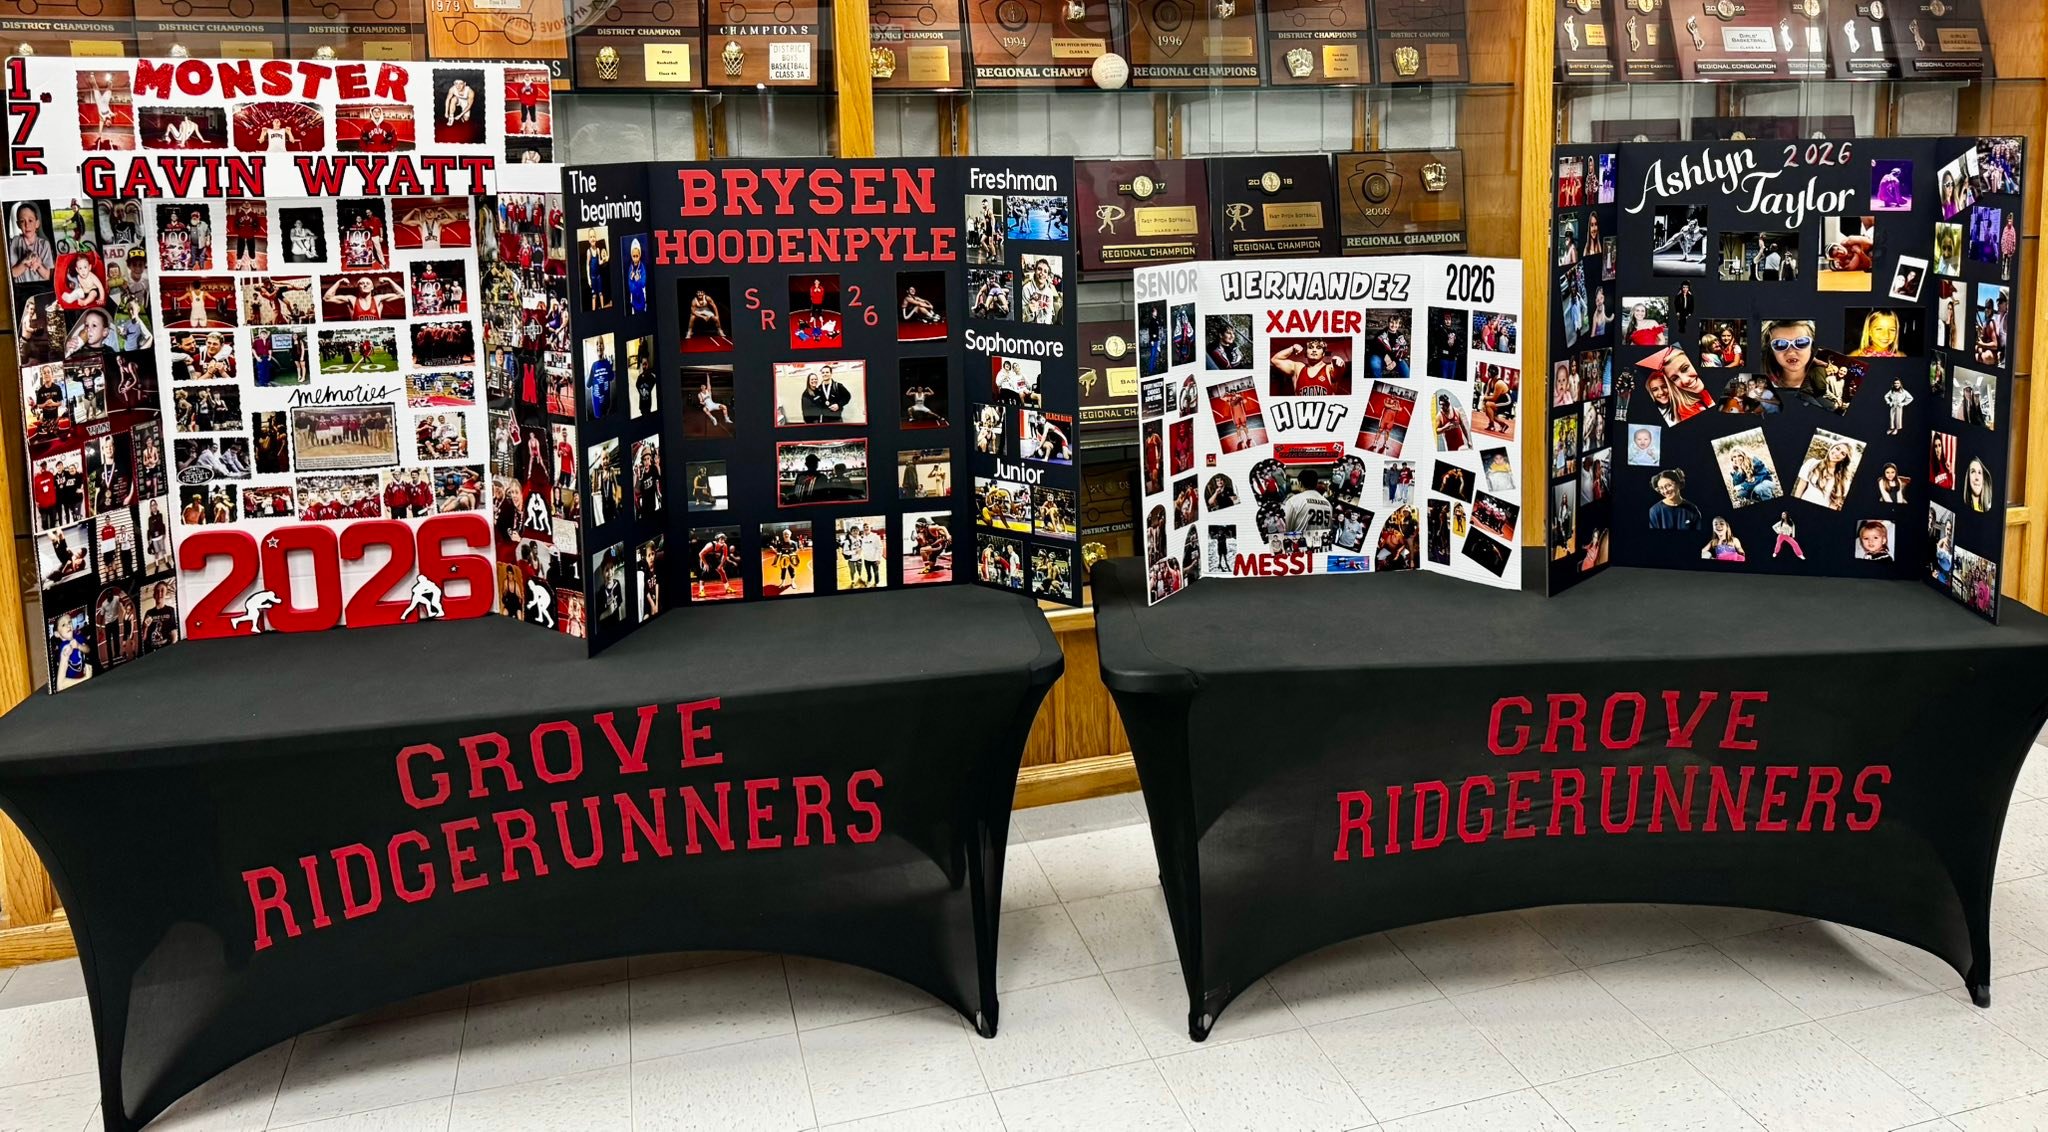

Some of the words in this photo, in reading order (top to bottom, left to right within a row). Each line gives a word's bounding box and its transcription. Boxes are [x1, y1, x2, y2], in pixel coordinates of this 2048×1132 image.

[431, 1, 460, 12] 1979
[2, 21, 50, 30] DISTRICT
[53, 22, 115, 32] CHAMPIONS
[158, 23, 204, 32] DISTRICT
[206, 24, 265, 33] CHAMPIONS
[309, 26, 350, 34] DISTRICT
[352, 26, 406, 34] CHAMPIONS
[597, 28, 635, 36] DISTRICT
[637, 28, 681, 36] CHAMPION
[720, 26, 809, 35] CHAMPIONS
[773, 45, 806, 53] DISTRICT
[1003, 37, 1027, 48] 1994
[1158, 36, 1182, 46] 1996
[771, 62, 808, 71] BASKETBALL
[782, 54, 798, 62] BOYS
[133, 59, 409, 101] MONSTER
[977, 67, 1040, 77] REGIONAL
[1134, 67, 1190, 77] REGIONAL
[1192, 66, 1257, 76] CHAMPIONS
[1783, 142, 1853, 168] 2026
[81, 156, 266, 199] GAVIN
[297, 155, 495, 198] WYATT
[569, 170, 597, 195] The
[970, 168, 1057, 192] Freshman
[1624, 148, 1757, 214] Ashlyn
[677, 168, 936, 218] BRYSEN
[1736, 170, 1855, 229] Taylor
[581, 195, 642, 225] beginning
[1365, 208, 1391, 216] 2006
[161, 231, 188, 243] 100
[655, 227, 956, 265] HOODENPYLE
[1233, 243, 1275, 252] REGIONAL
[1277, 241, 1320, 249] CHAMPION
[1347, 236, 1401, 247] REGIONAL
[1404, 233, 1460, 244] CHAMPION
[1102, 250, 1147, 258] REGIONAL
[1150, 247, 1195, 257] CHAMPION
[1136, 268, 1198, 300] SENIOR
[1221, 270, 1411, 301] HERNANDEZ
[1446, 263, 1496, 303] 2026
[1265, 309, 1362, 335] XAVIER
[965, 329, 1064, 358] Sophomore
[288, 384, 401, 405] memories
[1269, 401, 1349, 432] HWT
[994, 457, 1044, 485] Junior
[1308, 508, 1330, 526] 285
[180, 514, 494, 641] 2026
[1487, 690, 1768, 755] GROVE
[395, 697, 723, 809] GROVE
[1333, 764, 1893, 861] RIDGERUNNERS
[241, 769, 883, 951] RIDGERUNNERS
